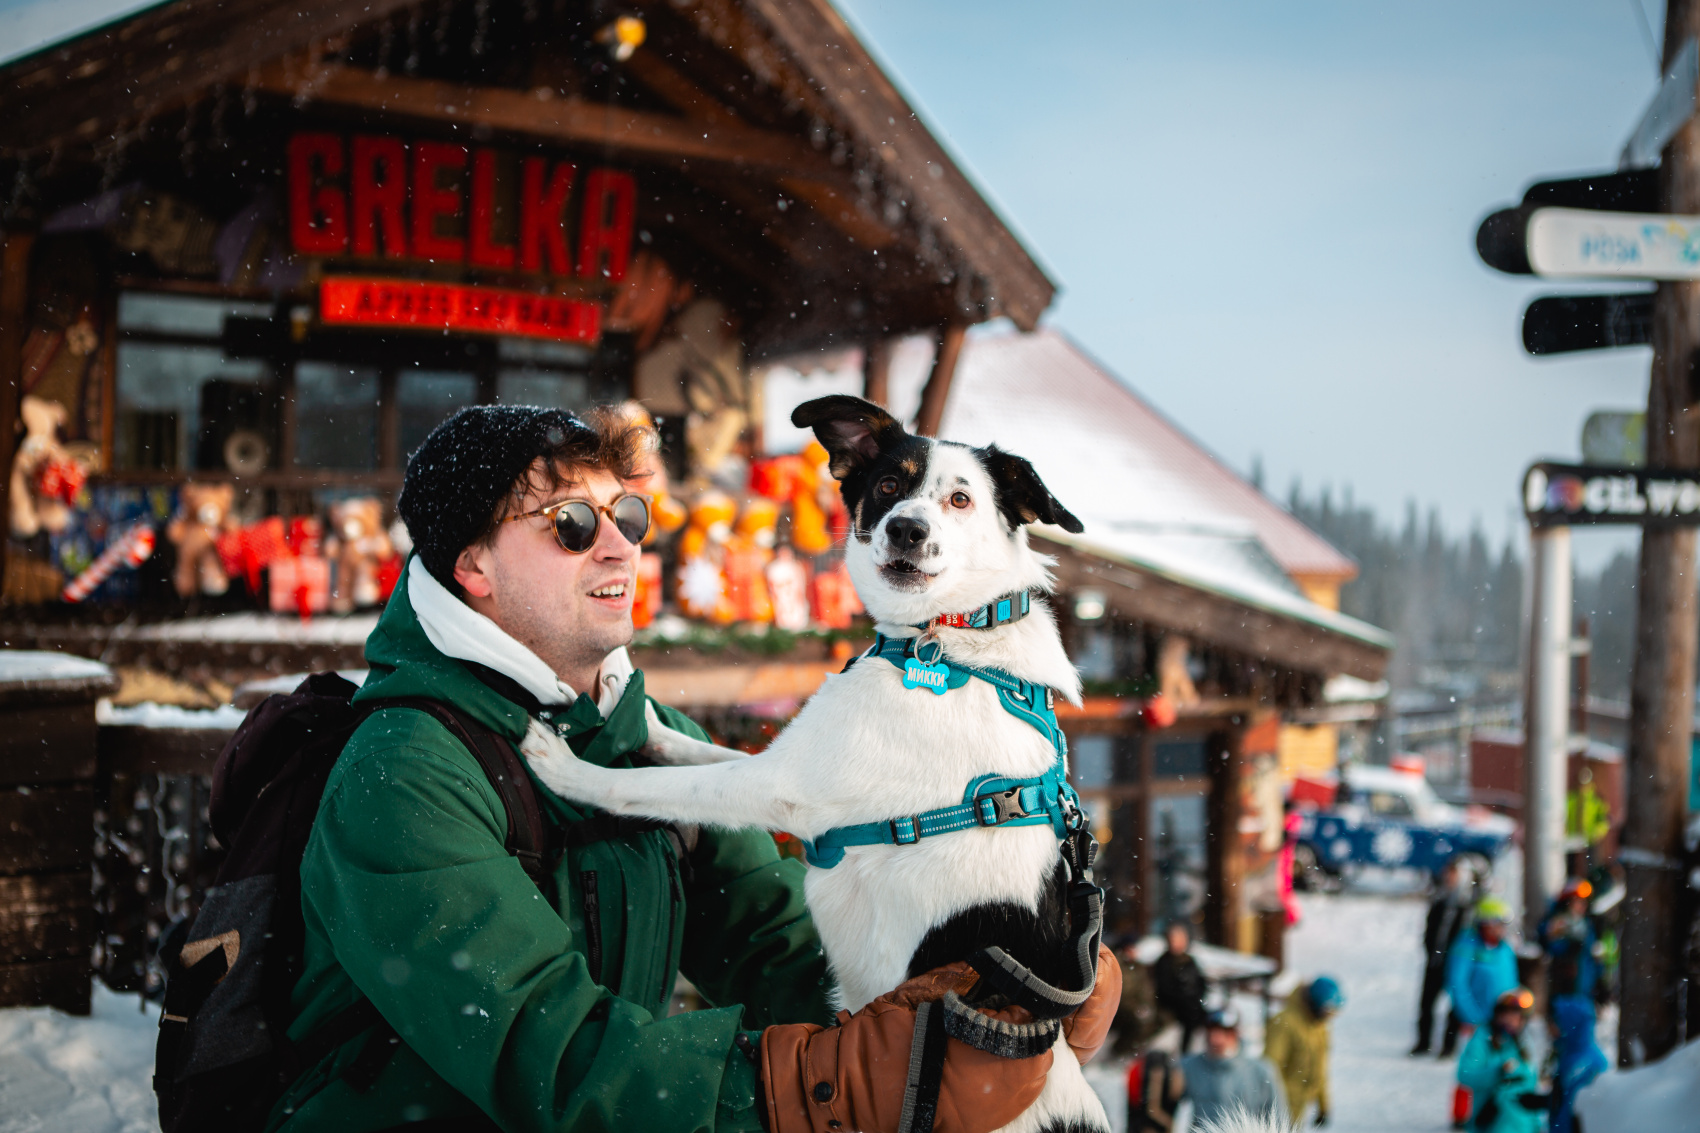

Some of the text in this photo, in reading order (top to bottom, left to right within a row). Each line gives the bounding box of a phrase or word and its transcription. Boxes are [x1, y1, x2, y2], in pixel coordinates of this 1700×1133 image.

[288, 132, 637, 282] GRELKA
[907, 667, 945, 687] МИККИ
[1069, 835, 1078, 867] TRUELOVE
